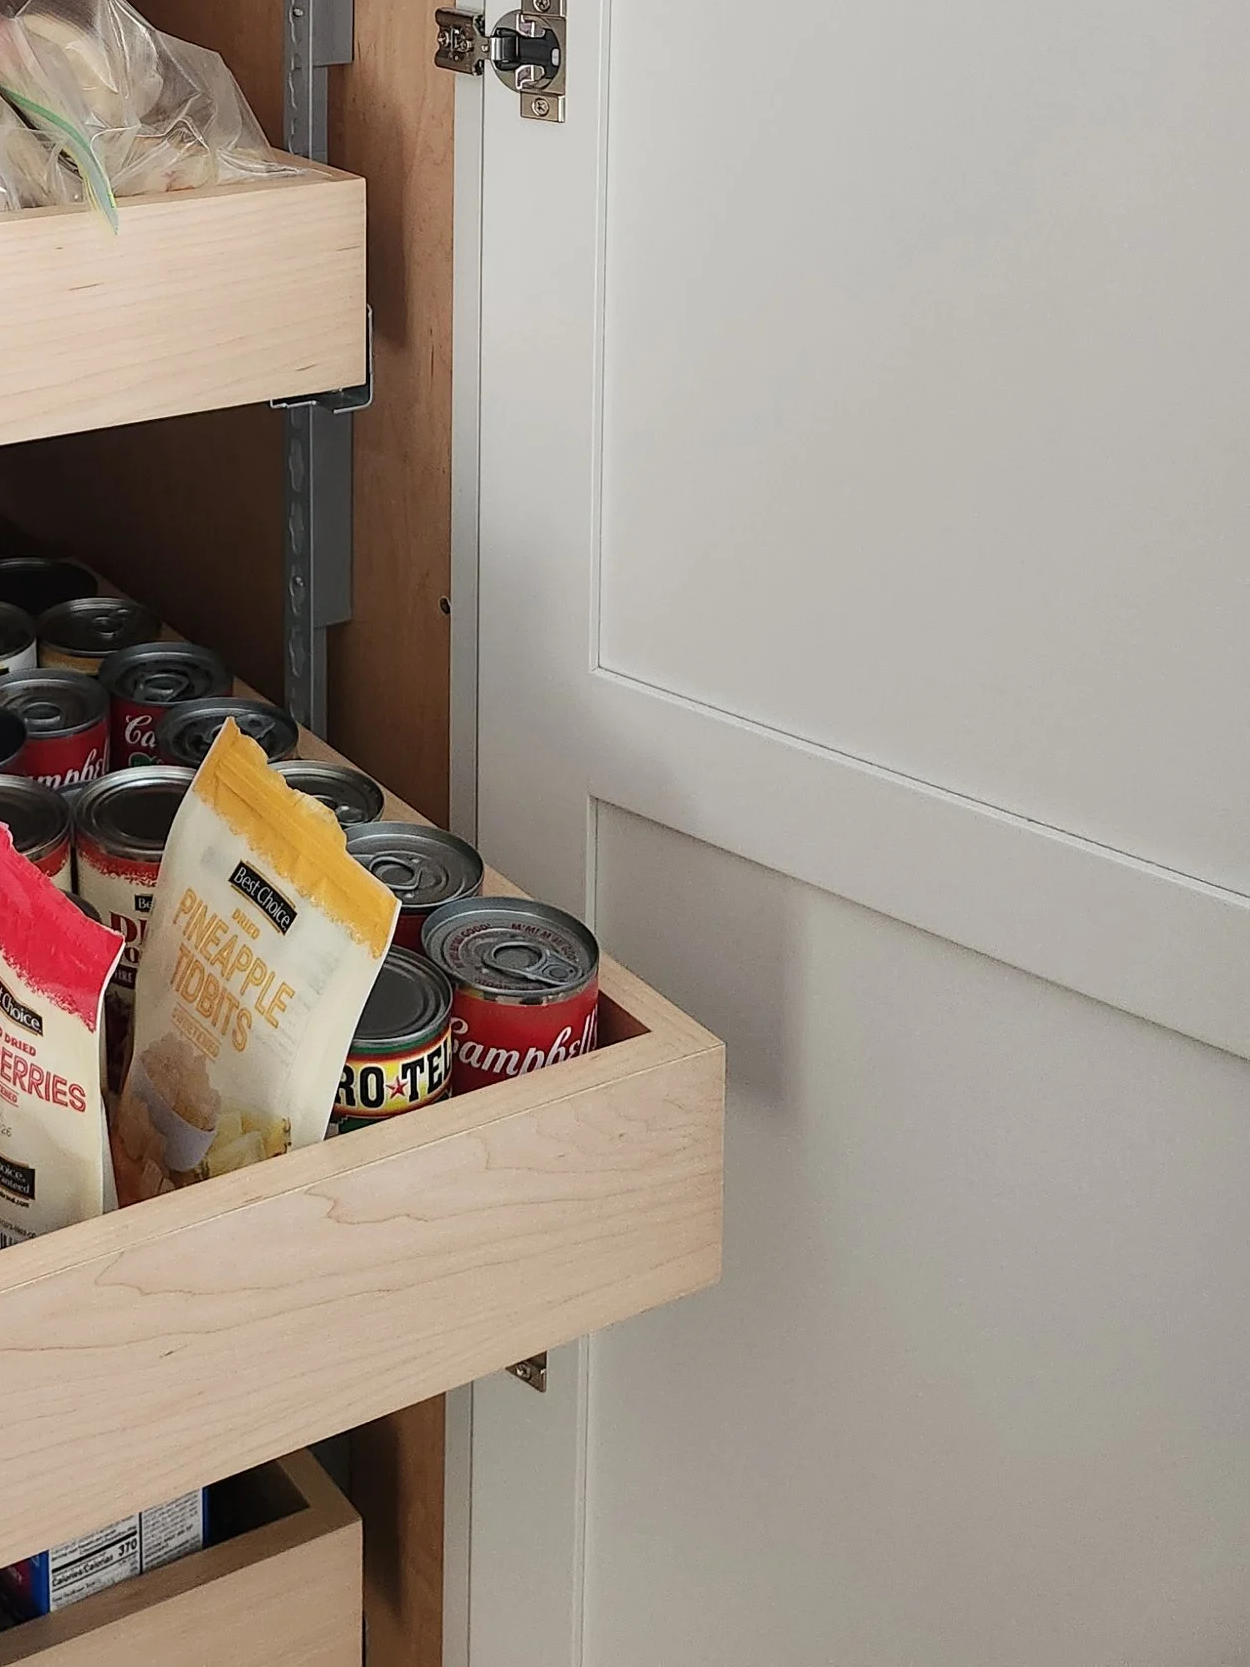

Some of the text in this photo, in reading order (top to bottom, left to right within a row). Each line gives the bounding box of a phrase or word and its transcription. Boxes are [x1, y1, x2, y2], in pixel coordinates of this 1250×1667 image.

[233, 866, 262, 899] Best
[231, 907, 261, 941] DRIED
[172, 887, 296, 1029] PINEAPPLE
[168, 942, 254, 1053] TIDBITS
[4, 1031, 37, 1058] DRIED
[117, 1537, 139, 1559] 370
